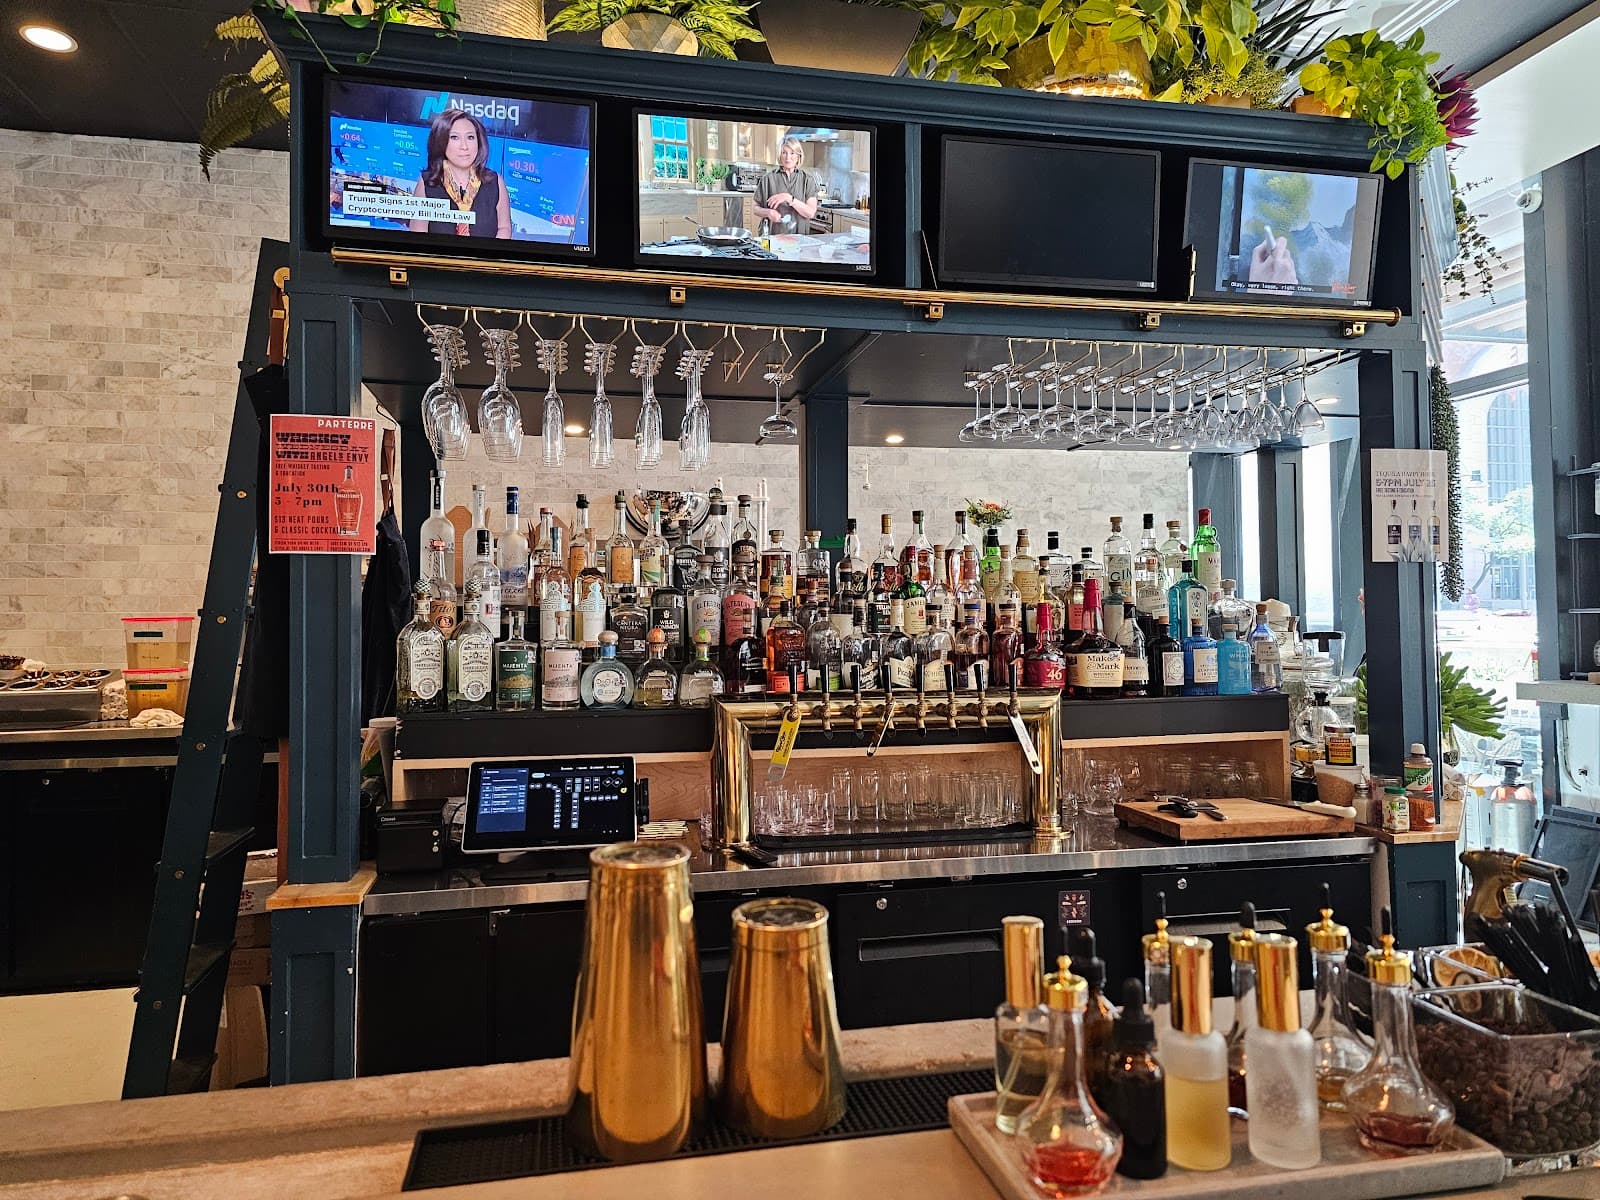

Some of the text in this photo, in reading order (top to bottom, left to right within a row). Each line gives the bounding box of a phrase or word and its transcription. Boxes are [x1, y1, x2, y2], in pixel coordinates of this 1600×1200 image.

[450, 98, 520, 126] Nasdaq
[514, 160, 535, 173] 0.30
[348, 194, 376, 204] Trump
[379, 196, 403, 206] Signs
[421, 200, 446, 210] Major
[348, 204, 416, 217] Cryptocurrency
[434, 211, 451, 219] Into
[453, 213, 471, 221] Law
[551, 213, 576, 226] CNN
[317, 419, 373, 431] PARTERRE
[275, 450, 309, 460] WITH
[347, 452, 369, 463] ENVY
[275, 482, 339, 495] July 30th
[1375, 479, 1402, 487] 5-7PM
[1403, 479, 1425, 487] JULY
[274, 497, 322, 508] 5 7pm
[281, 526, 308, 534] CLASSIC
[312, 527, 347, 535] COCKTAILS
[1047, 668, 1063, 681] 46
